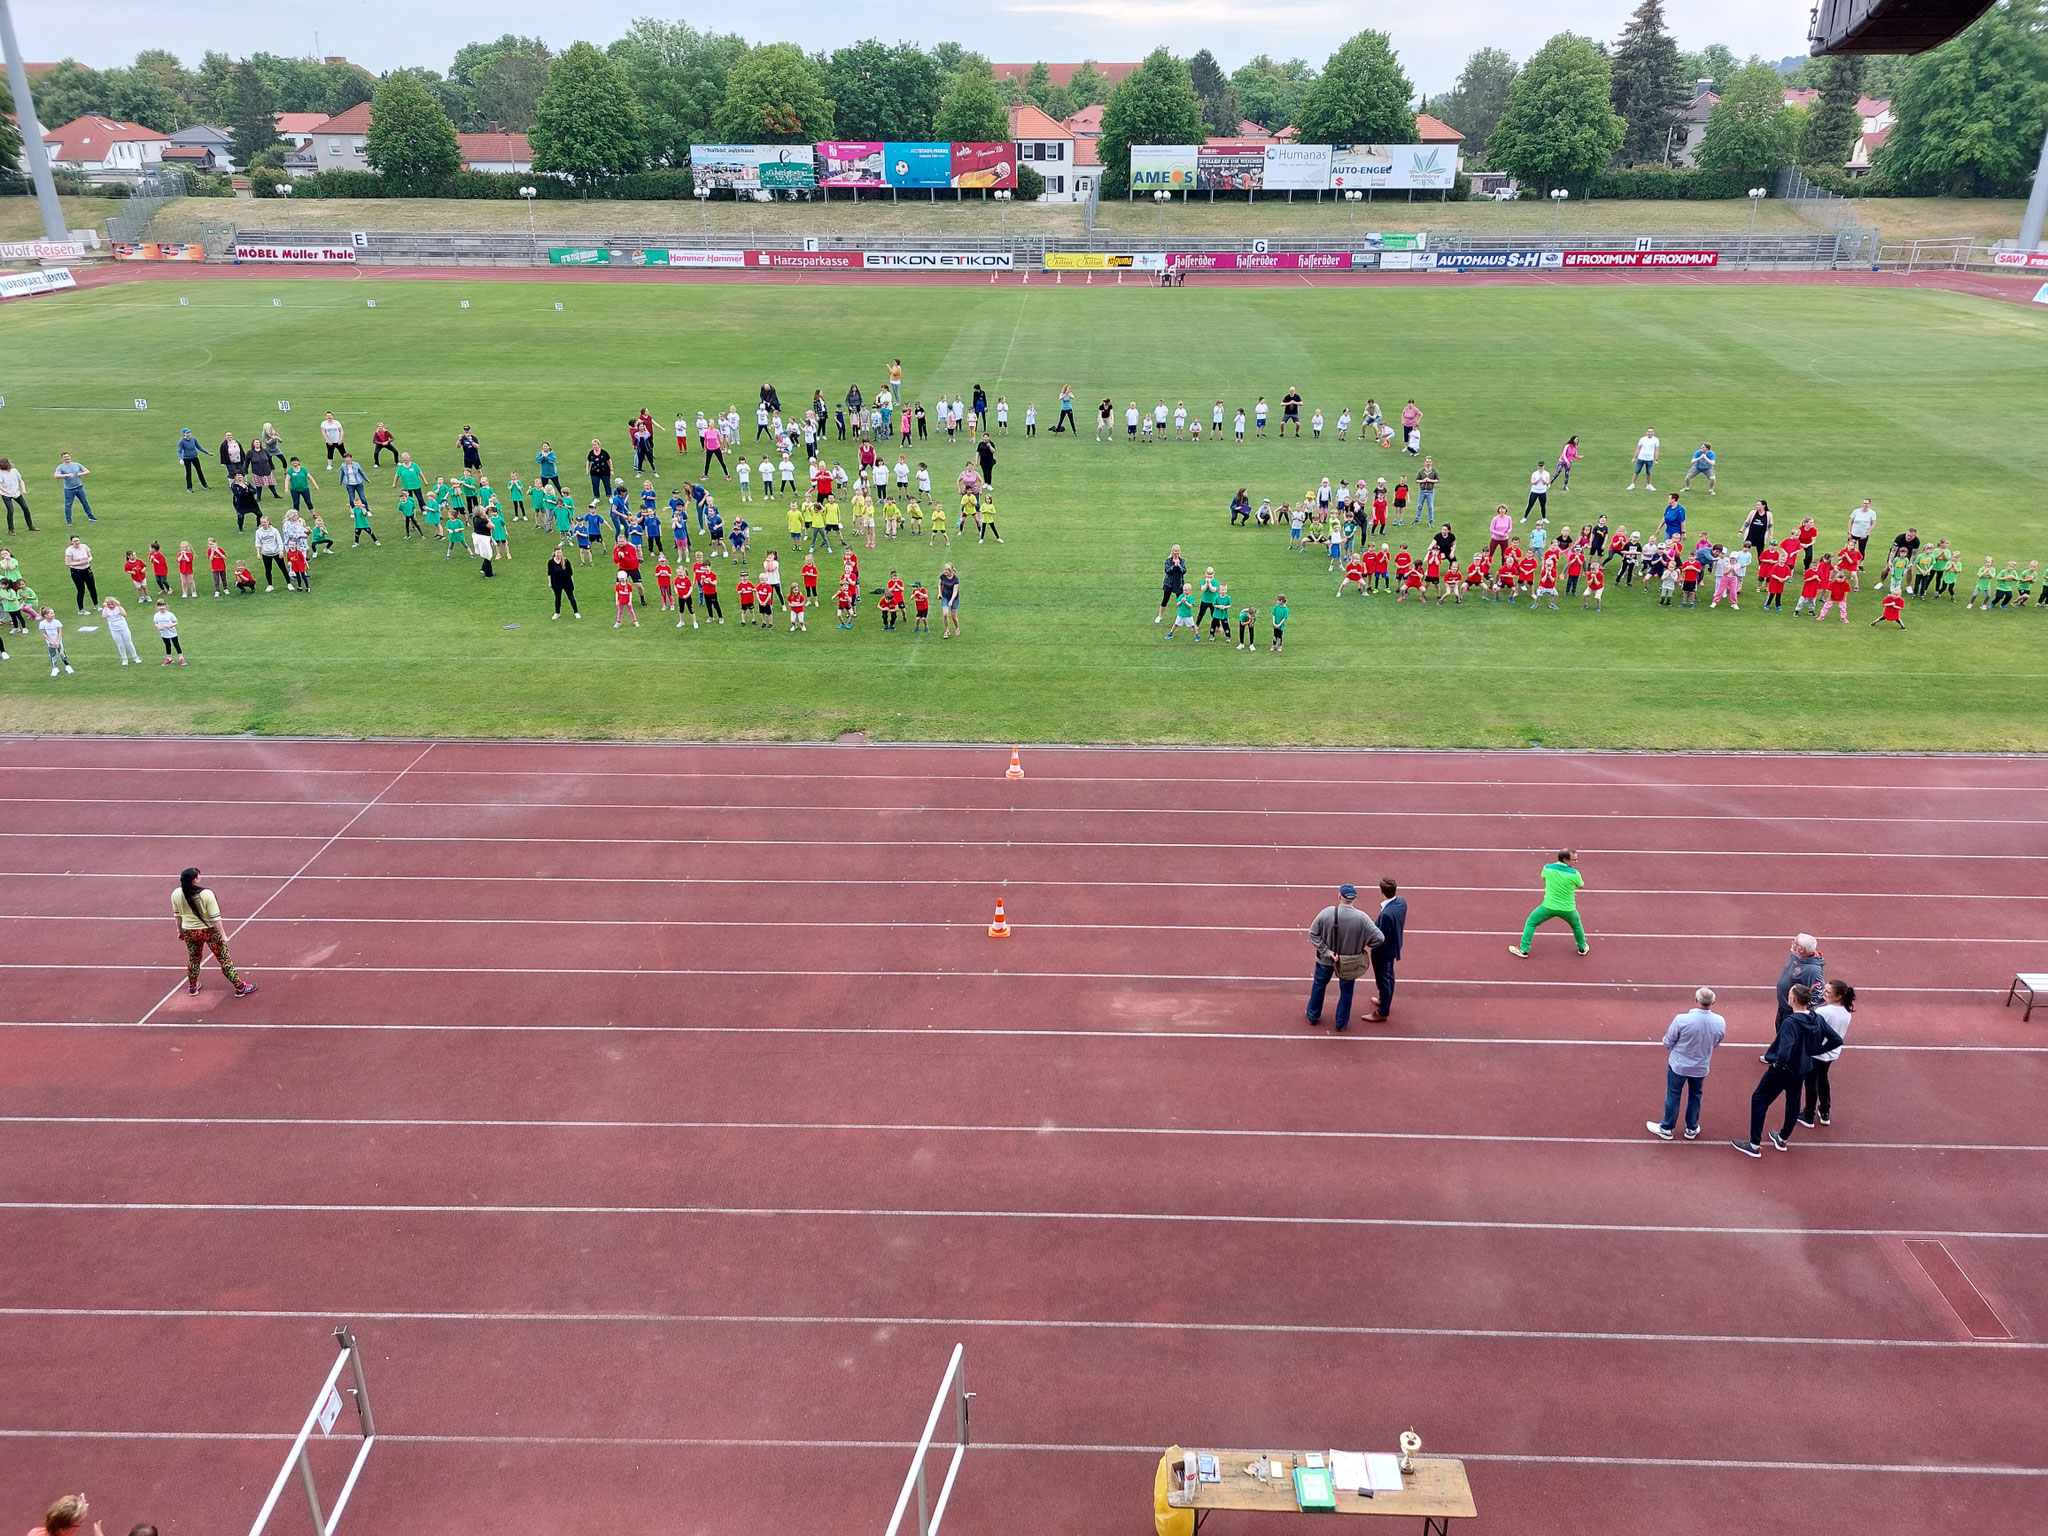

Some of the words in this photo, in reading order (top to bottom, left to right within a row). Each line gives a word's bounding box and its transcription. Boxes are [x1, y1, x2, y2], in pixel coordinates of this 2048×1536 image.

[1279, 149, 1327, 160] Humanas
[1332, 166, 1392, 174] AUTO-ENGEL
[1133, 171, 1193, 184] AMEOS
[355, 234, 365, 246] E
[1638, 239, 1649, 251] H
[2, 243, 75, 257] Wolf-Reisen
[1255, 241, 1266, 253] G
[238, 246, 279, 258] MÖBEL
[282, 249, 319, 260] Müller
[322, 250, 355, 260] Thale
[670, 253, 705, 262] Hammer
[2000, 254, 2025, 263] SAW
[707, 254, 743, 264] Hammer
[773, 255, 850, 267] Harzsparkasse
[867, 256, 936, 265] ETIKON
[940, 256, 1010, 265] ETIKON
[1438, 255, 1507, 266] AUTOHAUS
[1507, 253, 1539, 267] S&H
[1576, 254, 1637, 265] FROXIMUN
[1652, 254, 1714, 265] FROXIMUN
[0, 276, 43, 291] NORDHARZ
[135, 399, 146, 408] 25
[279, 401, 289, 410] 30
